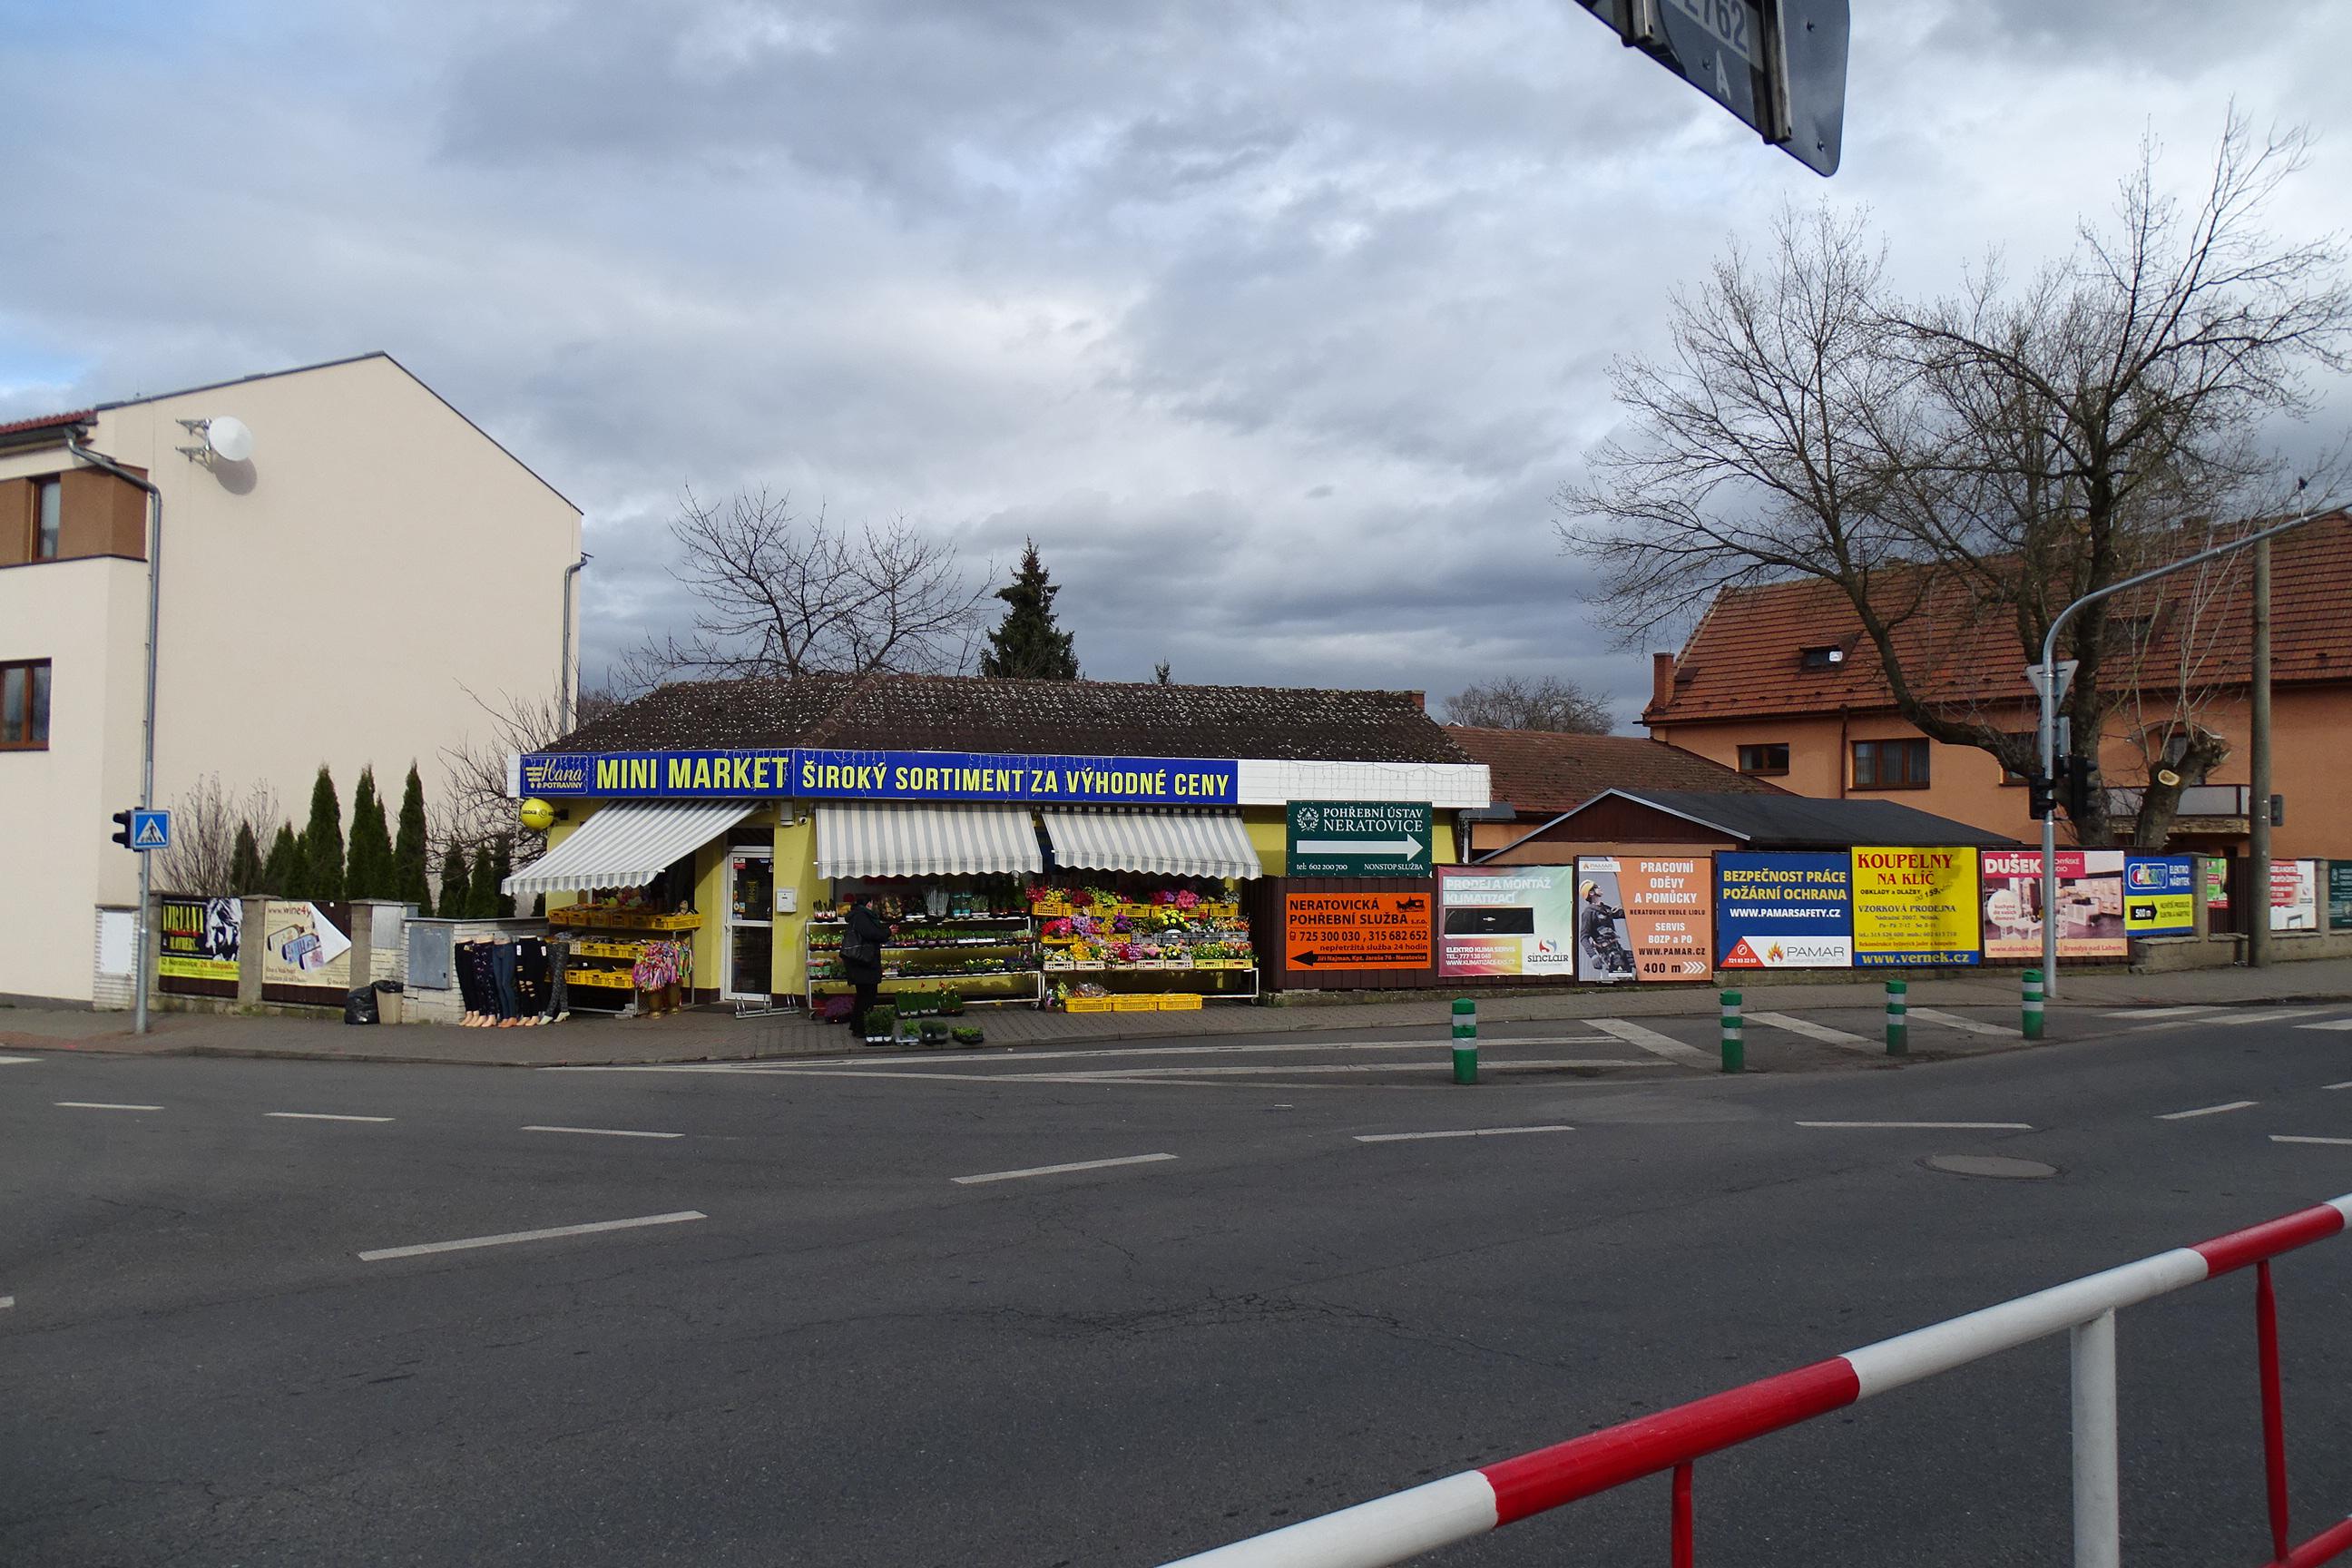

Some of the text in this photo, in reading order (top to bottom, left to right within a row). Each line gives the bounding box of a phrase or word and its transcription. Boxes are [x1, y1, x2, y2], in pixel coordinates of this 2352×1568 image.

[596, 757, 789, 789] MINI MARKET
[801, 760, 1230, 797] ŠIROKÝ SORTIMENT ZA VÝHODNÉ CENY
[1323, 806, 1424, 818] POHŘEBNÍ ÚSTAV
[1323, 819, 1424, 832] NERATOVICE
[1397, 862, 1424, 870] SLUŽBA
[1640, 860, 1694, 873] PRACOVNÍ
[1857, 853, 1954, 869] KOUPELNY
[1984, 853, 2043, 874] DUŠEK
[1723, 867, 1847, 883] BEZPEČNOST PRÁCE
[1877, 870, 1935, 885] NA KLÍČ
[1494, 878, 1504, 889] A
[1504, 877, 1552, 889] MONTÁŽ
[1650, 876, 1684, 888] ODĚVY
[1634, 889, 1698, 904] A POMŮCKY
[1722, 885, 1847, 900] POŽÁRNÍ OCHRANA
[1289, 897, 1379, 911] NERATOVICKÁ
[1857, 905, 1956, 913] VZORKOVÁ PRODEJNA
[1289, 912, 1356, 925] POHŘEBNÍ
[1359, 912, 1408, 925] SLUŽBA
[1730, 908, 1841, 917] WWW.PAMARSAFETY.CZ
[1654, 922, 1685, 931] SERVIS
[1299, 931, 1318, 942] 725
[1320, 931, 1339, 941] 300
[1341, 931, 1360, 941] 030
[1368, 931, 1387, 941] 315
[1388, 930, 1407, 941] 682
[1409, 930, 1428, 940] 652
[1648, 935, 1671, 944] BOZP
[1681, 935, 1692, 944] PO
[1366, 943, 1392, 951] služba
[1638, 947, 1706, 956] WWW.PAMAR.CZ
[1787, 946, 1845, 957] PAMAR
[1862, 952, 1970, 964] www.vernek.cz
[1643, 962, 1681, 973] 400 m
